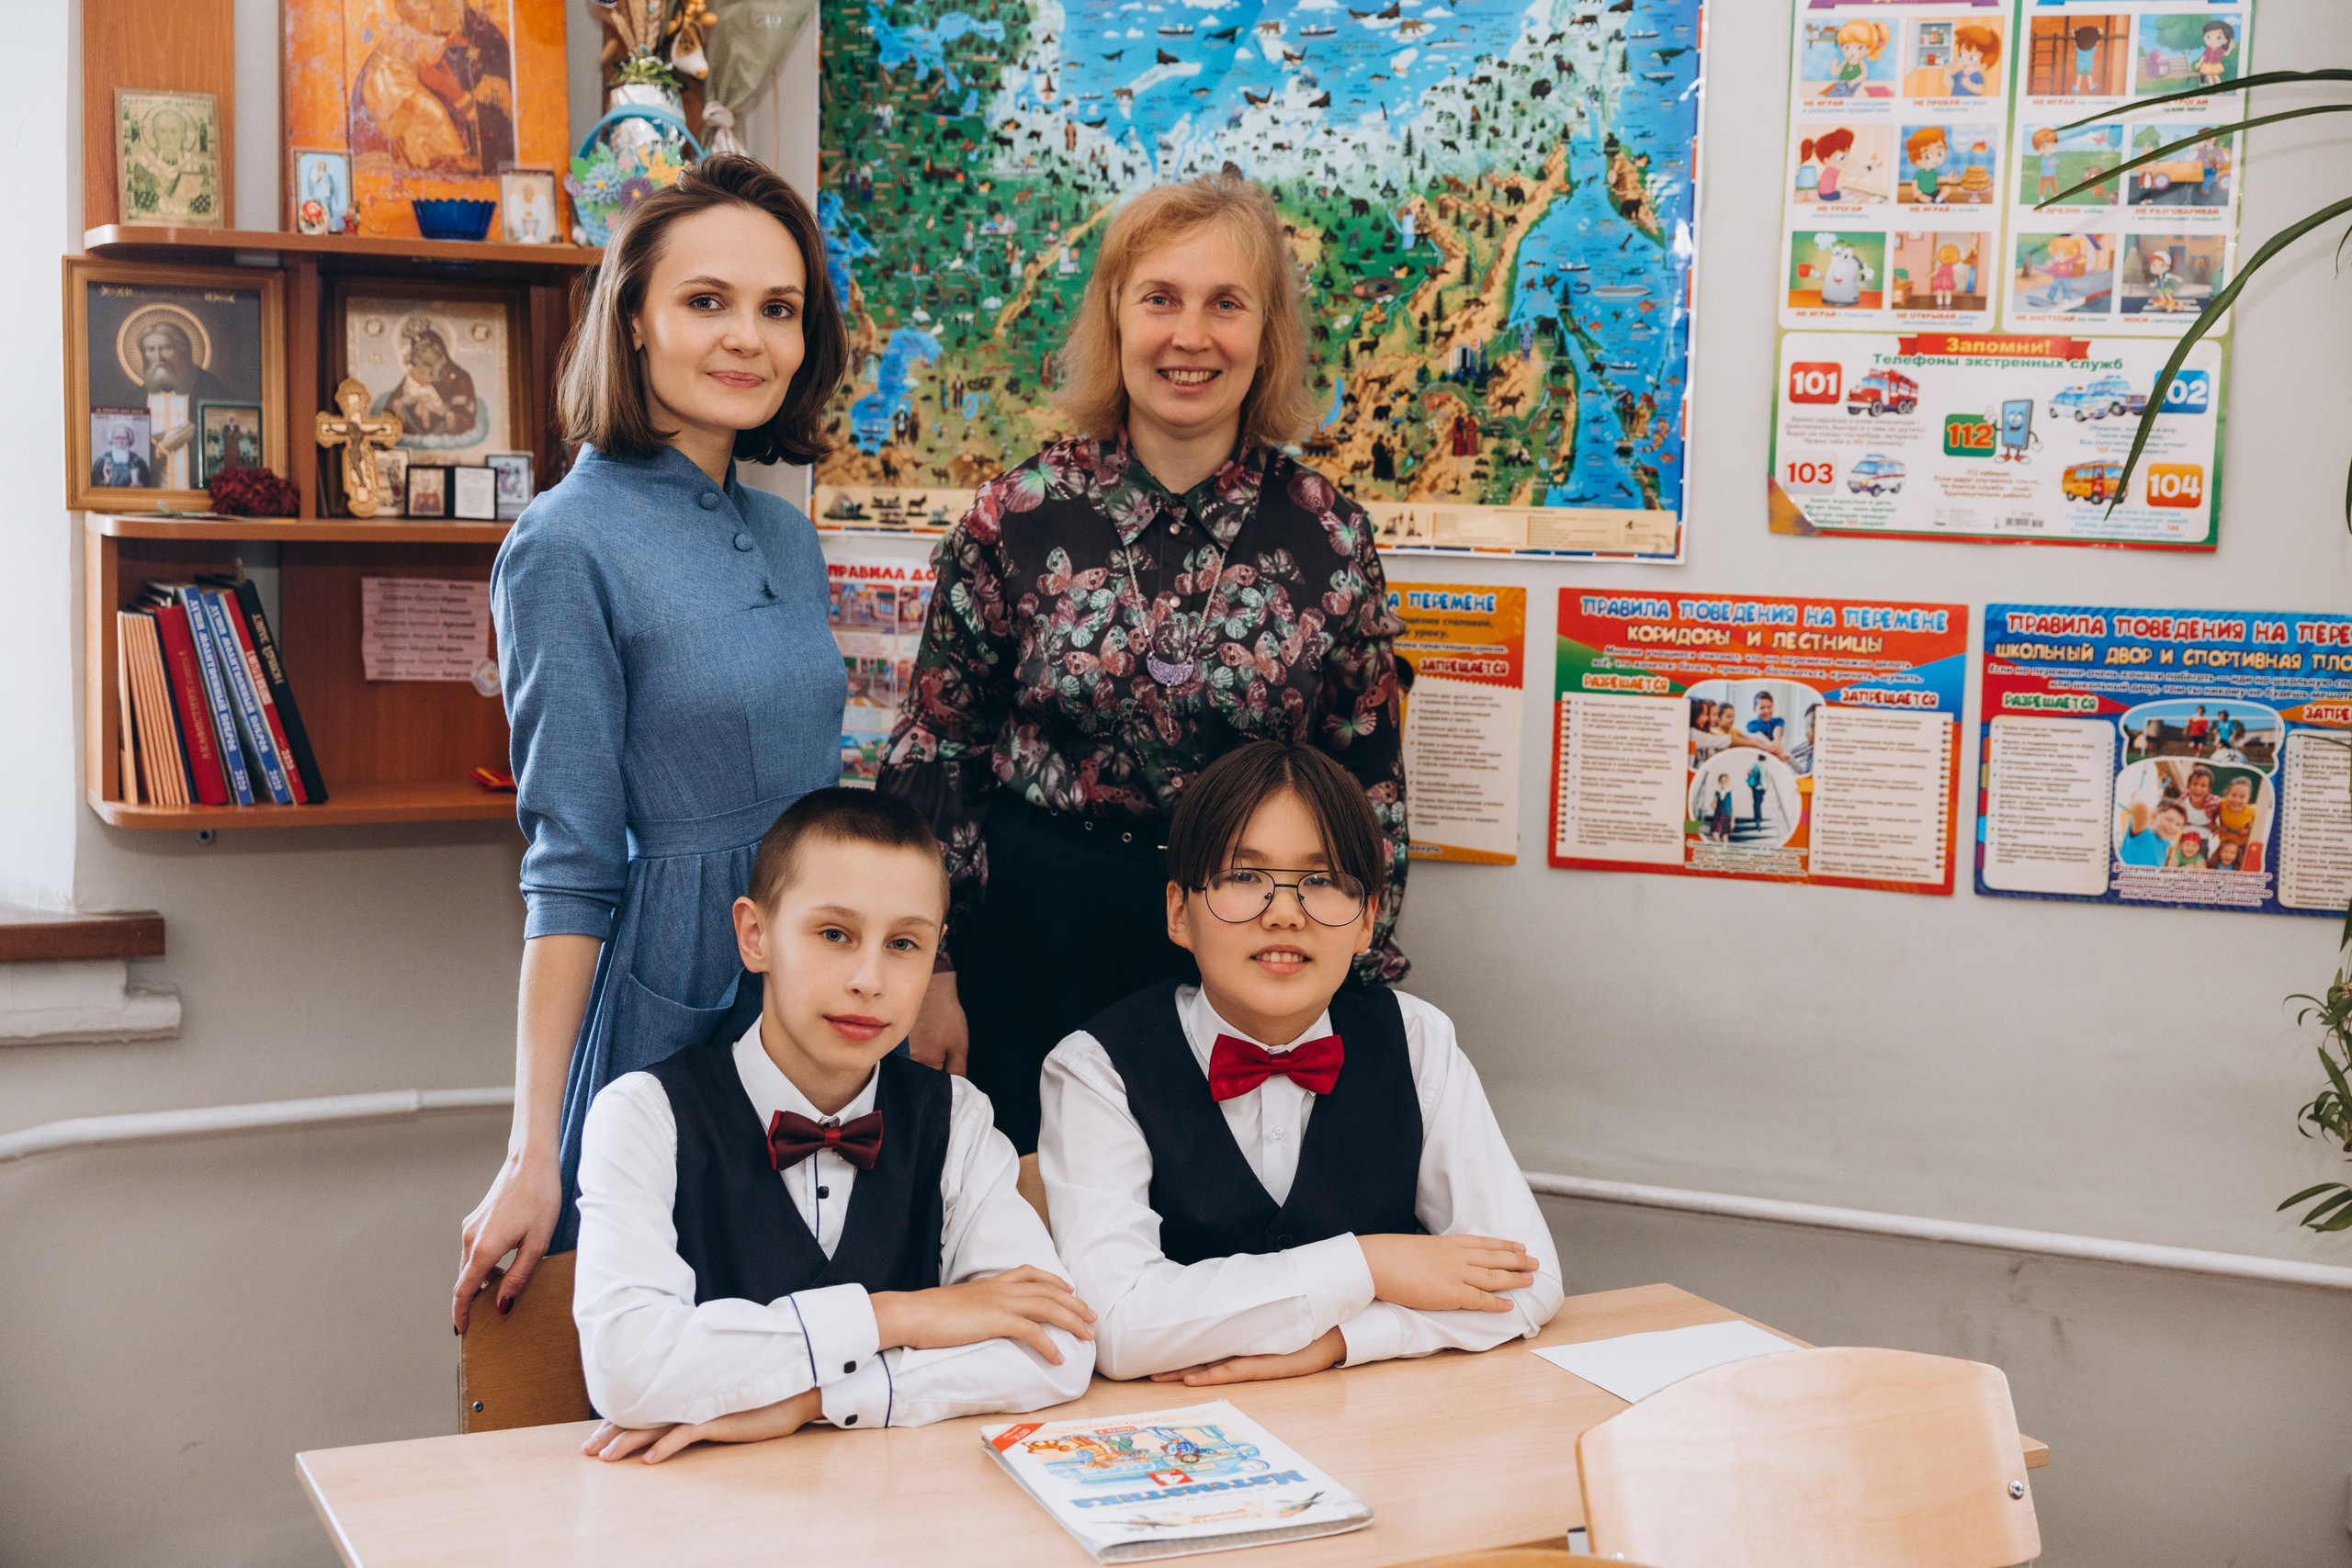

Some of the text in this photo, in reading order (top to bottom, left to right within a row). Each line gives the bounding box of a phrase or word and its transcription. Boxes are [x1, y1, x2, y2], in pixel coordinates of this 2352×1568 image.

[1945, 336, 2051, 355] Запомни!
[1872, 353, 2122, 372] Телефоны экстренных служб
[1792, 370, 1838, 396] 101
[2164, 379, 2208, 404] 02
[1947, 423, 1995, 448] 112
[1787, 462, 1834, 485] 103
[2149, 473, 2201, 499] 104
[828, 565, 905, 581] ПРАВИЛА
[1408, 592, 1496, 613] ПЕРЕМЕНЕ
[1581, 597, 1949, 632] ПРАВИЛА ПОВЕДЕНИЯ НА ПЕРЕМЕНЕ
[252, 613, 270, 645] ЗАВЕТ
[1627, 626, 1883, 653] КОРИДОРЫ И ЛЕСТНИЦЫ
[2007, 613, 2352, 645] ПРАВИЛА ПОВЕДЕНИЯ НА ПЕРЕ
[261, 645, 285, 685] НОВЫЙ
[1419, 658, 1509, 675] ЗАПРЕЩАЕТСЯ
[1995, 642, 2094, 661] ШКОЛЬНЫЙ
[2104, 646, 2153, 665] ДВОР
[2160, 648, 2174, 665] И
[2182, 648, 2301, 670] СПОРТИВНАЯ
[1582, 673, 1669, 692] РАЗРЕШАЕТСЯ
[1840, 689, 1939, 707] ЗАПРЕЩАЕТСЯ
[2003, 693, 2099, 711] РАЗРЕШАЕТСЯ
[2303, 705, 2351, 721] ЗАПРЕ
[1113, 1426, 1134, 1434] Часть
[1070, 1470, 1308, 1508] Математика
[1155, 1473, 1185, 1485] 4
